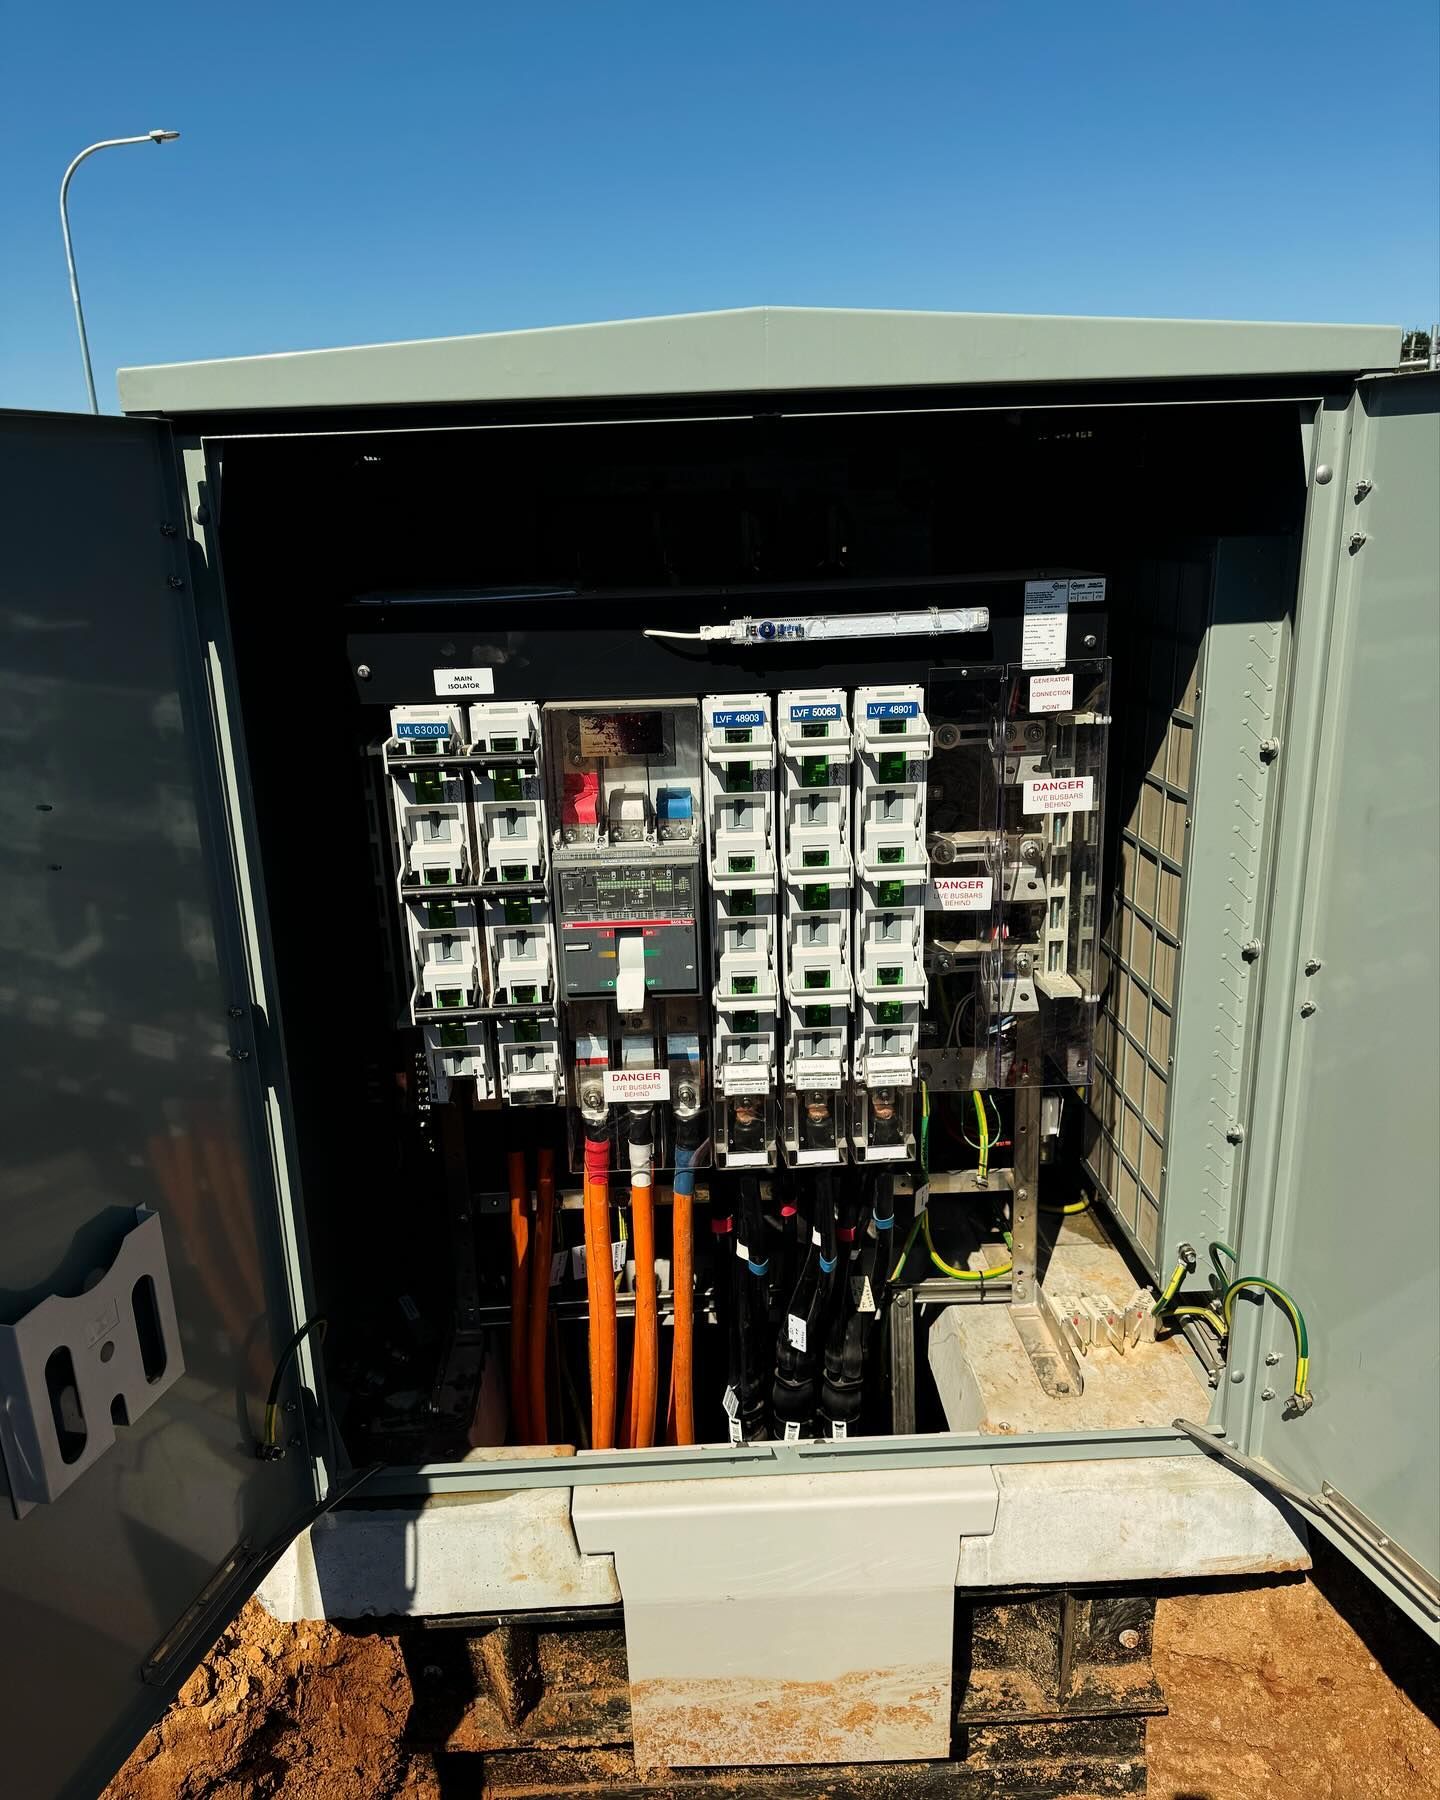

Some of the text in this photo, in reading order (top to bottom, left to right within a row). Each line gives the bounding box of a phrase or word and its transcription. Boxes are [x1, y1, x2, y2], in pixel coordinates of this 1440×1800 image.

[1033, 676, 1070, 684] GENERATOR
[792, 709, 809, 717] LVF
[870, 705, 912, 714] LVF 48901
[715, 713, 760, 723] LVF 48903
[399, 726, 446, 735] LVL 63000
[1033, 780, 1084, 791] DANGER
[934, 881, 984, 890] DANGER
[612, 1073, 661, 1081] DANGER
